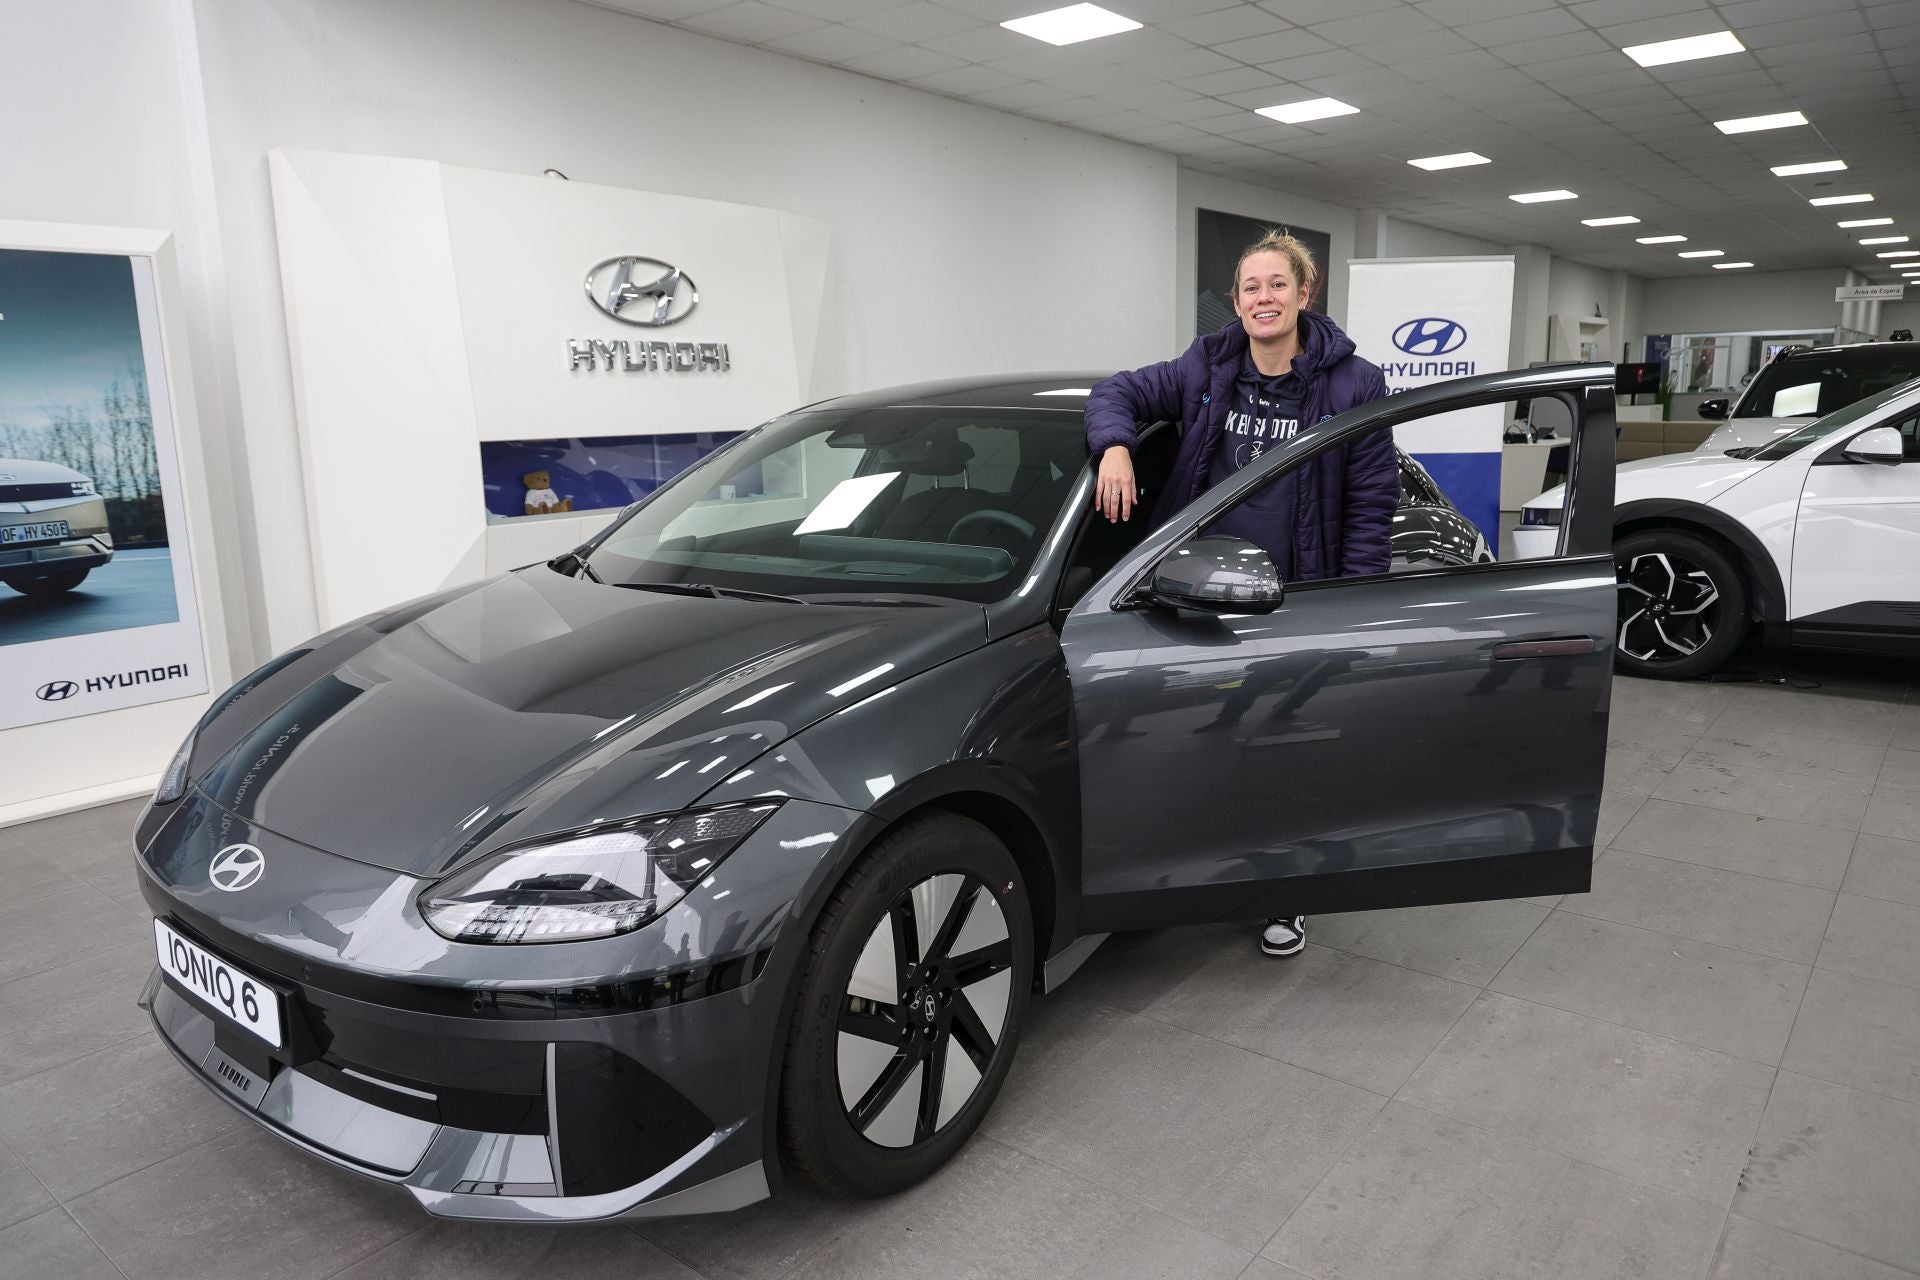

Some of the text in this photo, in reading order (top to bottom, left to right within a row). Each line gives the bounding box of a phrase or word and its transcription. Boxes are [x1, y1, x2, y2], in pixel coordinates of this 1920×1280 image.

[568, 339, 730, 372] HYUNDAI
[1381, 361, 1475, 377] HYUNDAI
[2, 527, 17, 542] OF
[24, 525, 38, 540] HY
[86, 664, 188, 693] HYUNDAI
[168, 931, 259, 1023] IONIQ 6
